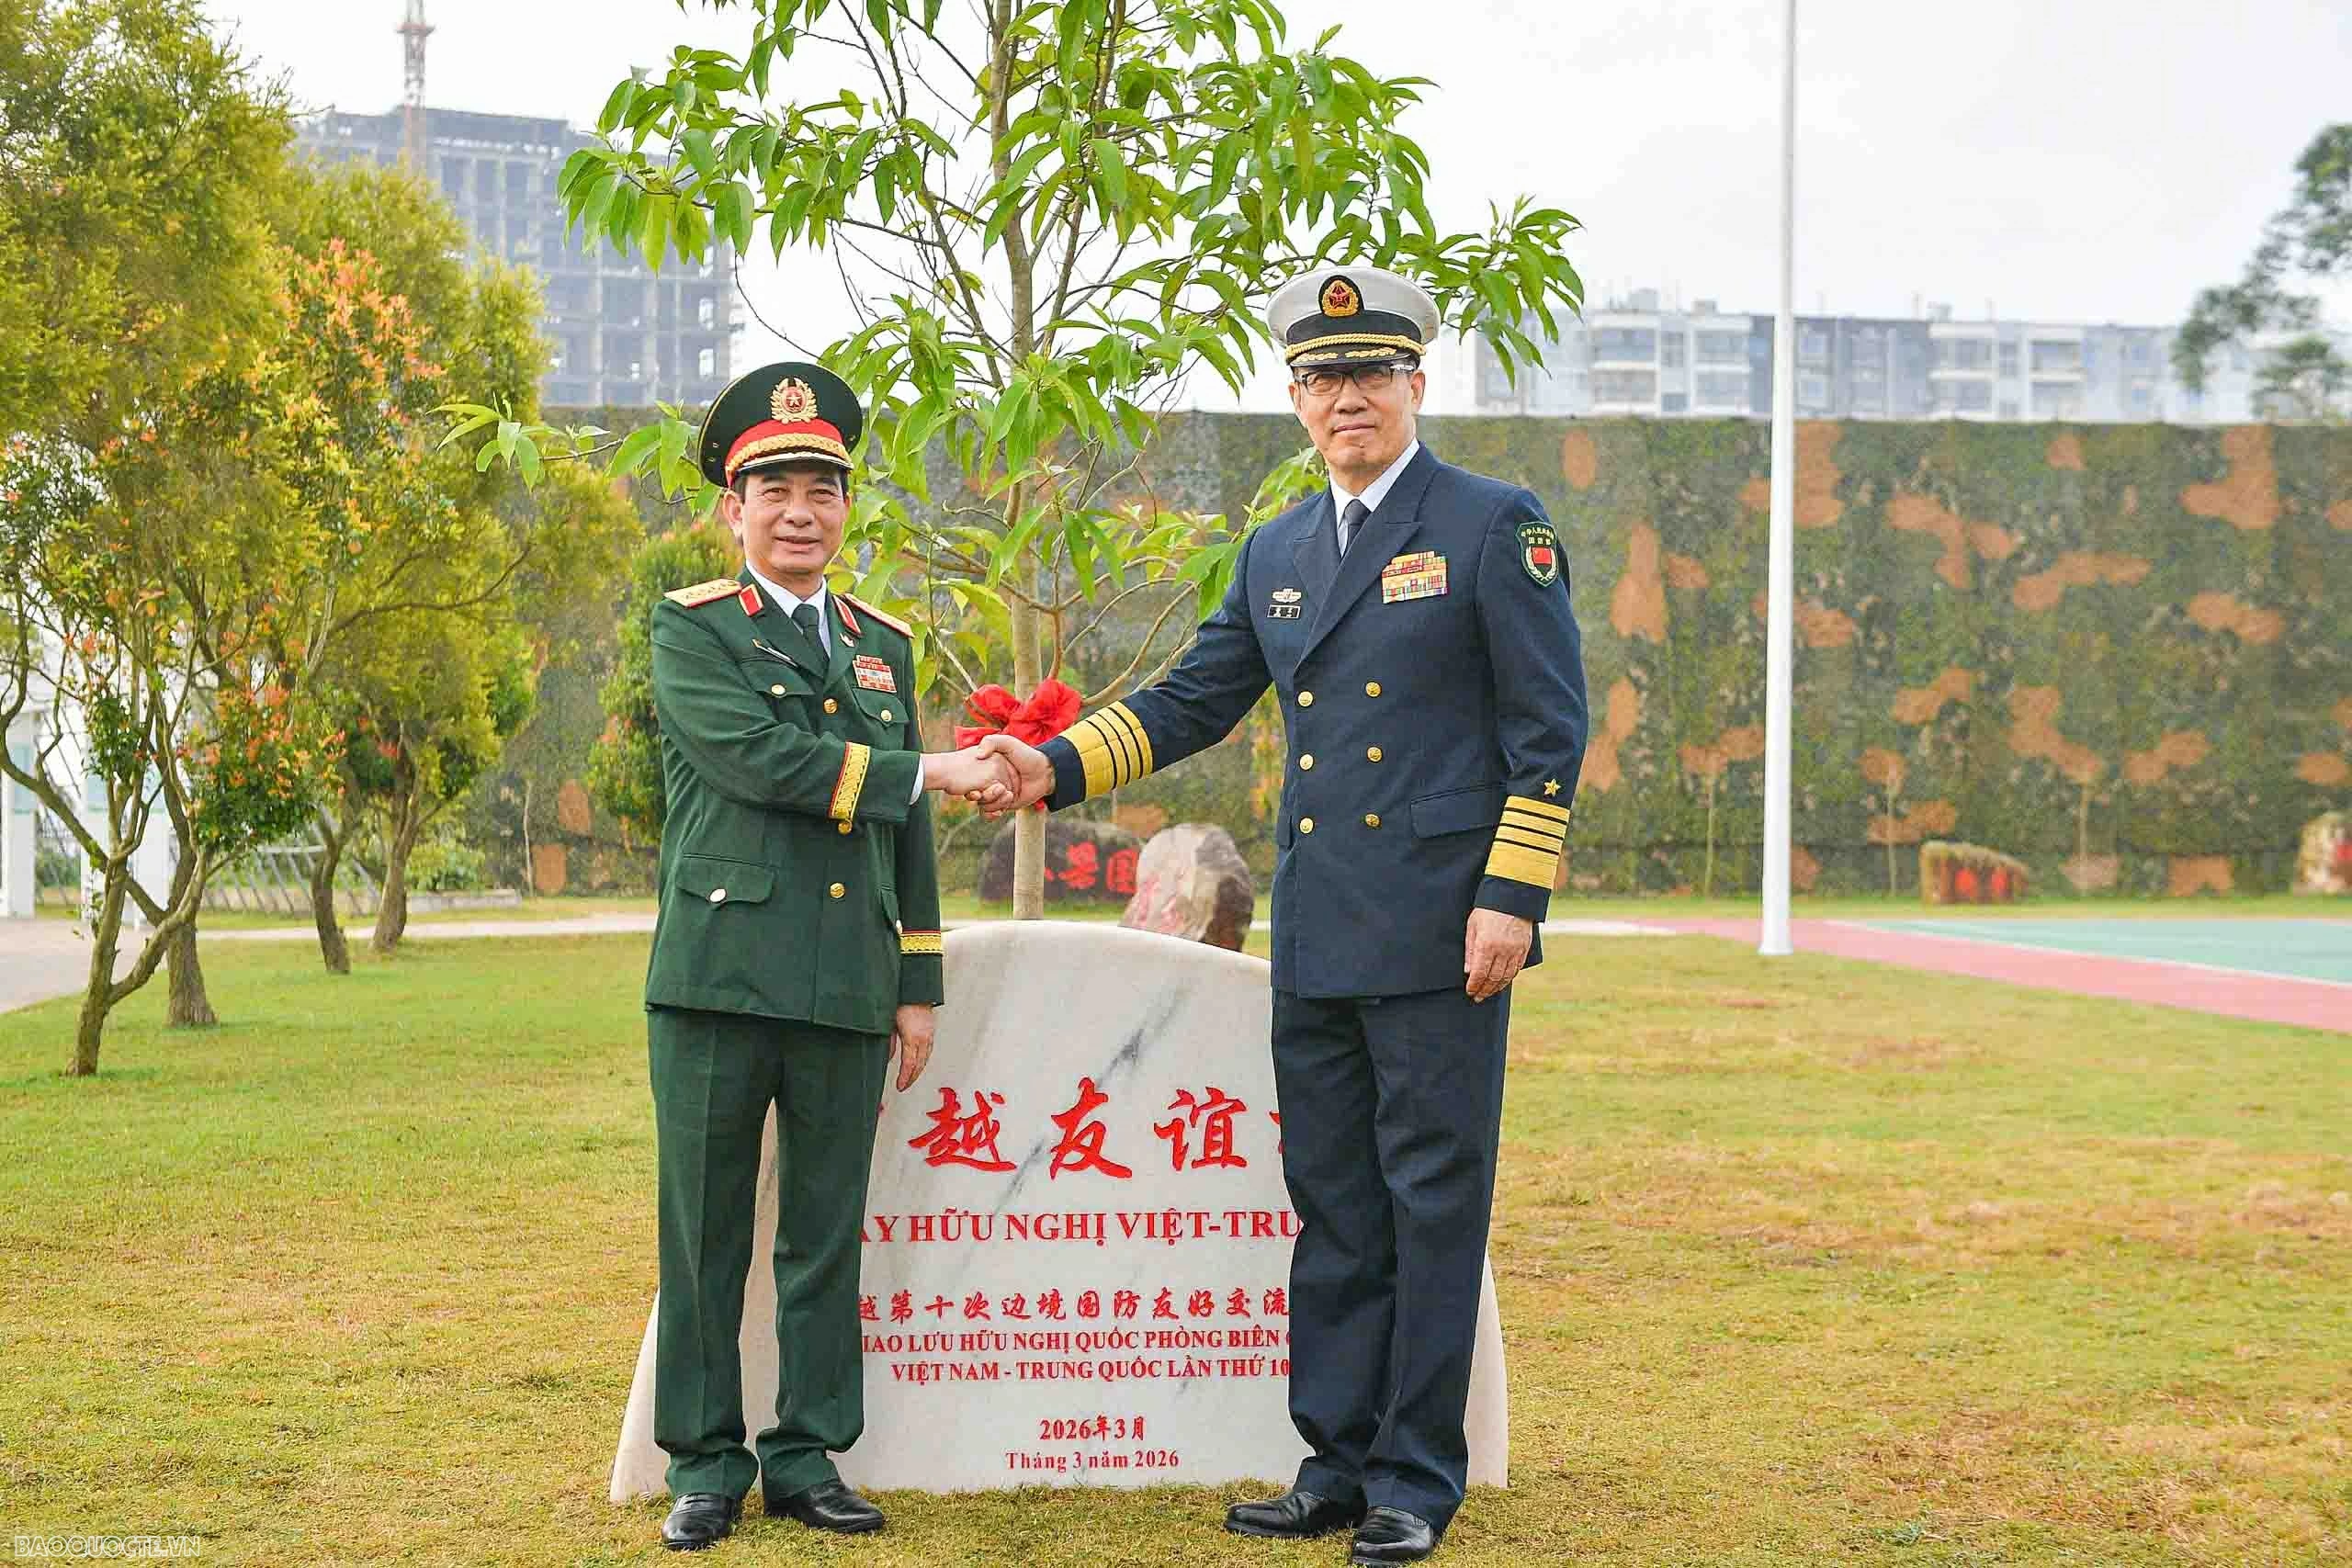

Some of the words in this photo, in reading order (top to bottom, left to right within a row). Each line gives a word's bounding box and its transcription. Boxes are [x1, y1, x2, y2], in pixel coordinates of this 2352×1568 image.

[876, 1077, 1283, 1179] 越友谊
[909, 1206, 994, 1242] HỮU
[1004, 1212, 1107, 1247] NGHỊ
[909, 1331, 954, 1353] LƯU
[960, 1329, 1008, 1352] HỮU
[1013, 1332, 1070, 1354] NGHỊ
[1075, 1325, 1139, 1353] QUỐC
[1144, 1325, 1223, 1349] PHÒNG
[1227, 1324, 1280, 1348] BIÊN
[891, 1360, 944, 1385] VIỆT
[948, 1361, 1000, 1382] NAM
[1016, 1360, 1093, 1381] TRUNG
[1098, 1355, 1163, 1382] QUỐC
[1168, 1355, 1213, 1378] LẦN
[1217, 1353, 1266, 1377] THỨ
[1039, 1415, 1146, 1441] 2026年3月
[1006, 1451, 1067, 1473] Tháng
[1072, 1451, 1082, 1470] 3
[1088, 1450, 1129, 1470] năm
[1135, 1450, 1181, 1468] 2026
